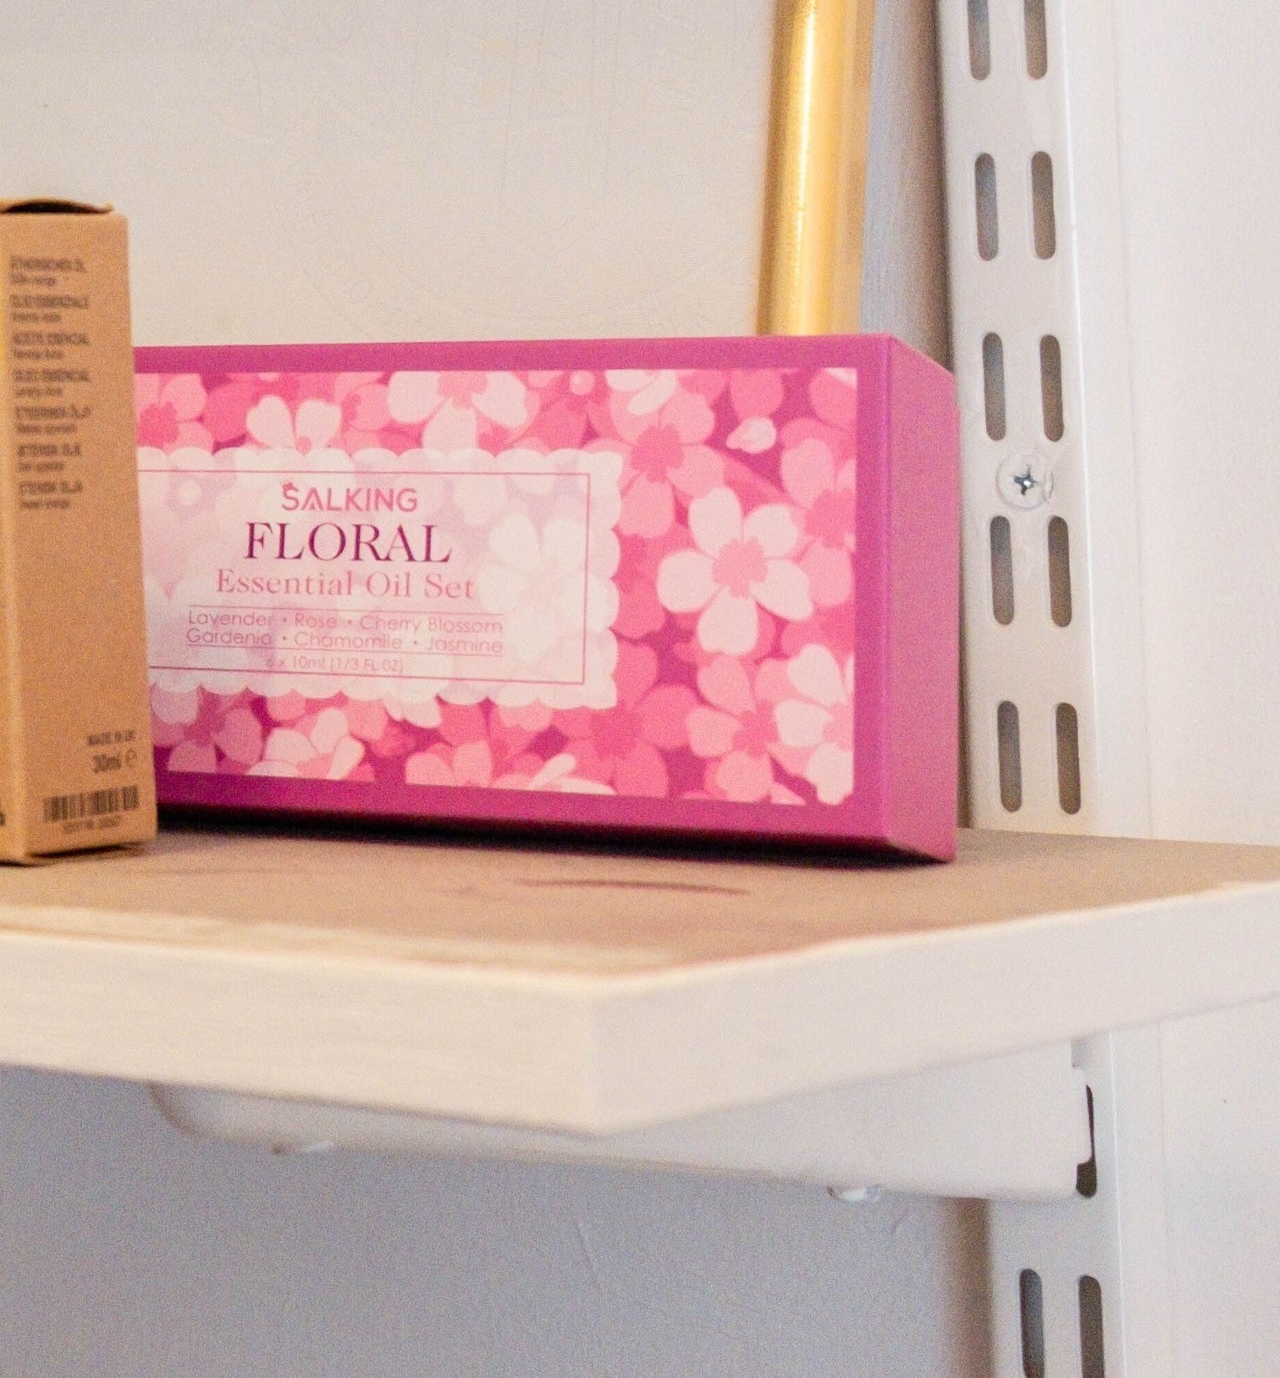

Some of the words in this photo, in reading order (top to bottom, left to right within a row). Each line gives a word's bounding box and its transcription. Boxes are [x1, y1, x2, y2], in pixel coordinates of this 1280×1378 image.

[281, 482, 419, 514] SALKING
[244, 521, 453, 564] FLORAL
[216, 568, 354, 598] Essential
[365, 571, 412, 599] Oil
[423, 573, 475, 601] Set
[188, 609, 274, 629] Lavender
[294, 612, 338, 630] Rose
[359, 614, 420, 635] Cherry
[427, 615, 504, 635] Blossom
[186, 628, 272, 646] Gardenia
[294, 631, 403, 650] Chamomile
[427, 637, 504, 655] Jasmine
